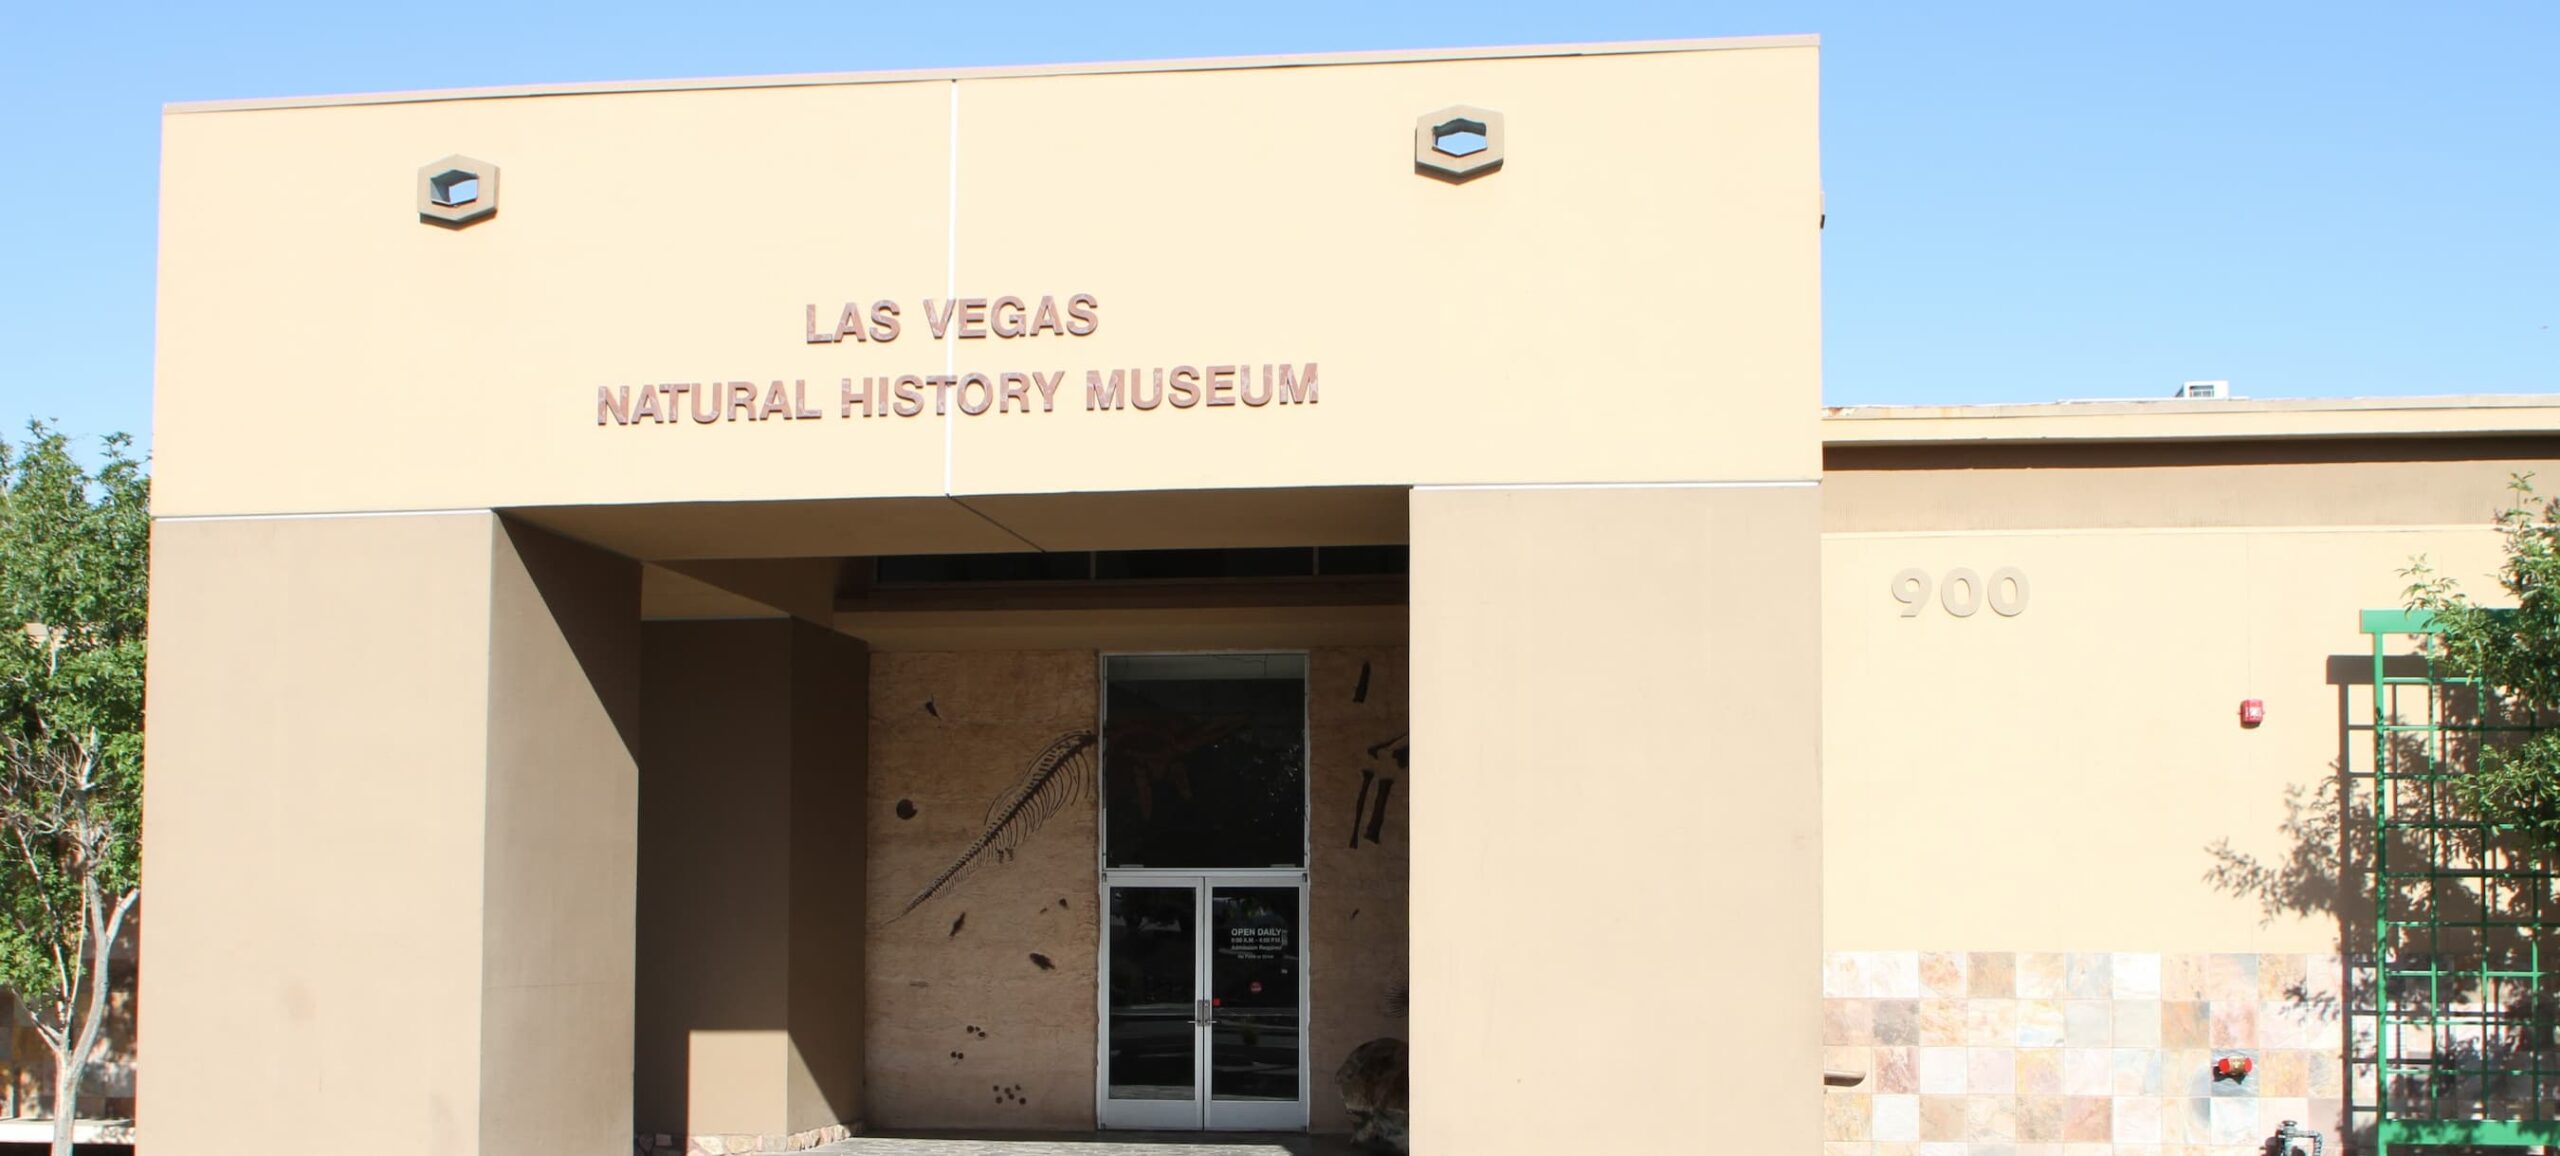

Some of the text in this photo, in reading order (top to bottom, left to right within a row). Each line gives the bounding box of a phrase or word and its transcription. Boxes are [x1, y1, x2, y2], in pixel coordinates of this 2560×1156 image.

[806, 293, 1099, 344] LAS VEGAS
[598, 363, 1319, 426] NATURAL HISTORY MUSEUM
[1891, 567, 2031, 618] 900
[1231, 928, 1281, 936] OPEN DAILY
